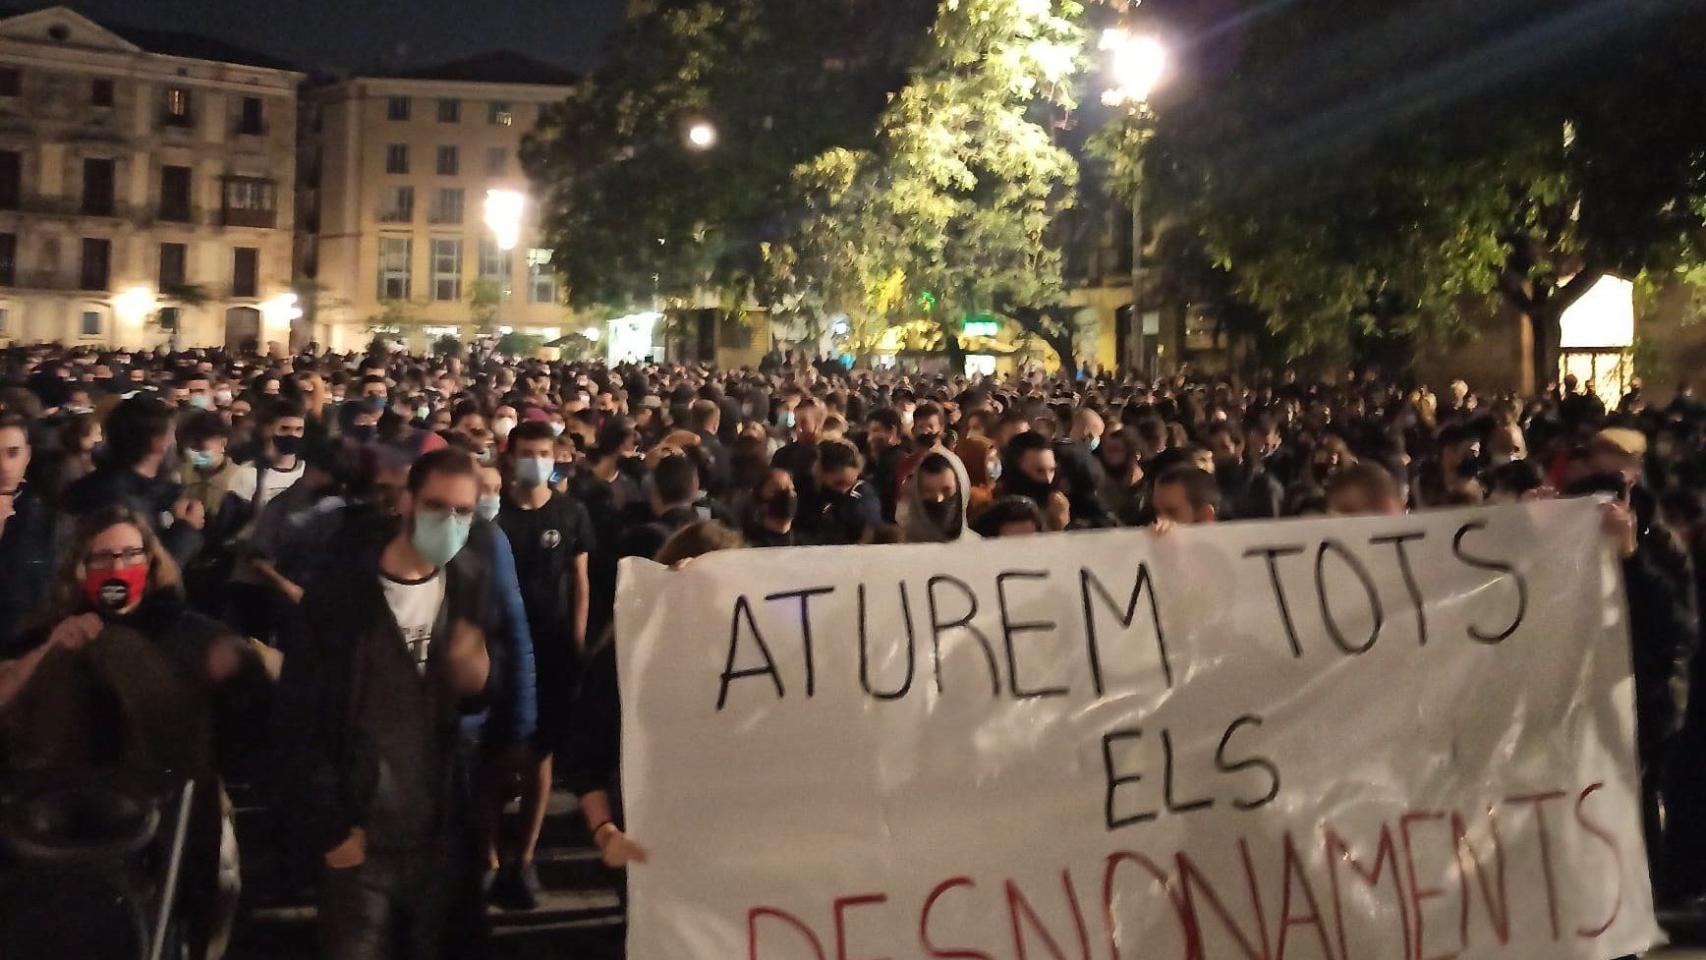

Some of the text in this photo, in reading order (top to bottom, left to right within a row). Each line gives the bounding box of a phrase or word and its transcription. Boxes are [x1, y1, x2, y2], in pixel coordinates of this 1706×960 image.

[716, 519, 1529, 711] ATUREM TOTS
[1102, 714, 1281, 832] ELS
